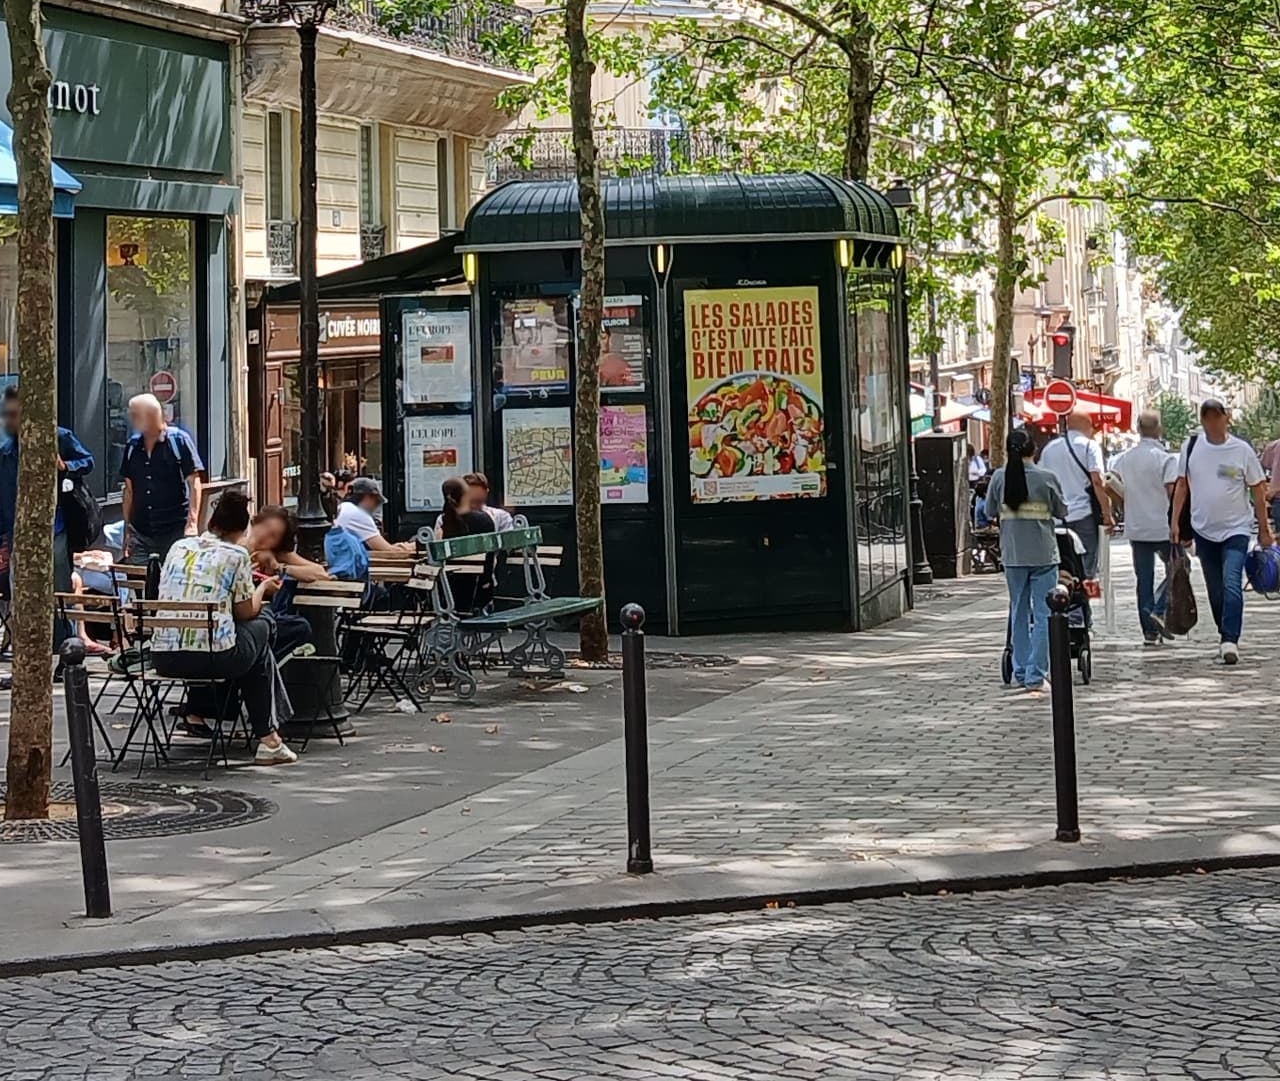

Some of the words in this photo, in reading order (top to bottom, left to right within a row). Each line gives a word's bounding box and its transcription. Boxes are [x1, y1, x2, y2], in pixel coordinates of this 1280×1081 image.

[328, 315, 356, 338] CUVÉE
[691, 304, 723, 329] LES
[729, 301, 813, 327] SALADES
[692, 328, 737, 351] C'EST
[742, 327, 777, 348] VITE
[781, 326, 814, 347] FAIT
[693, 350, 744, 380] BIEN
[753, 348, 815, 376] FRAIS
